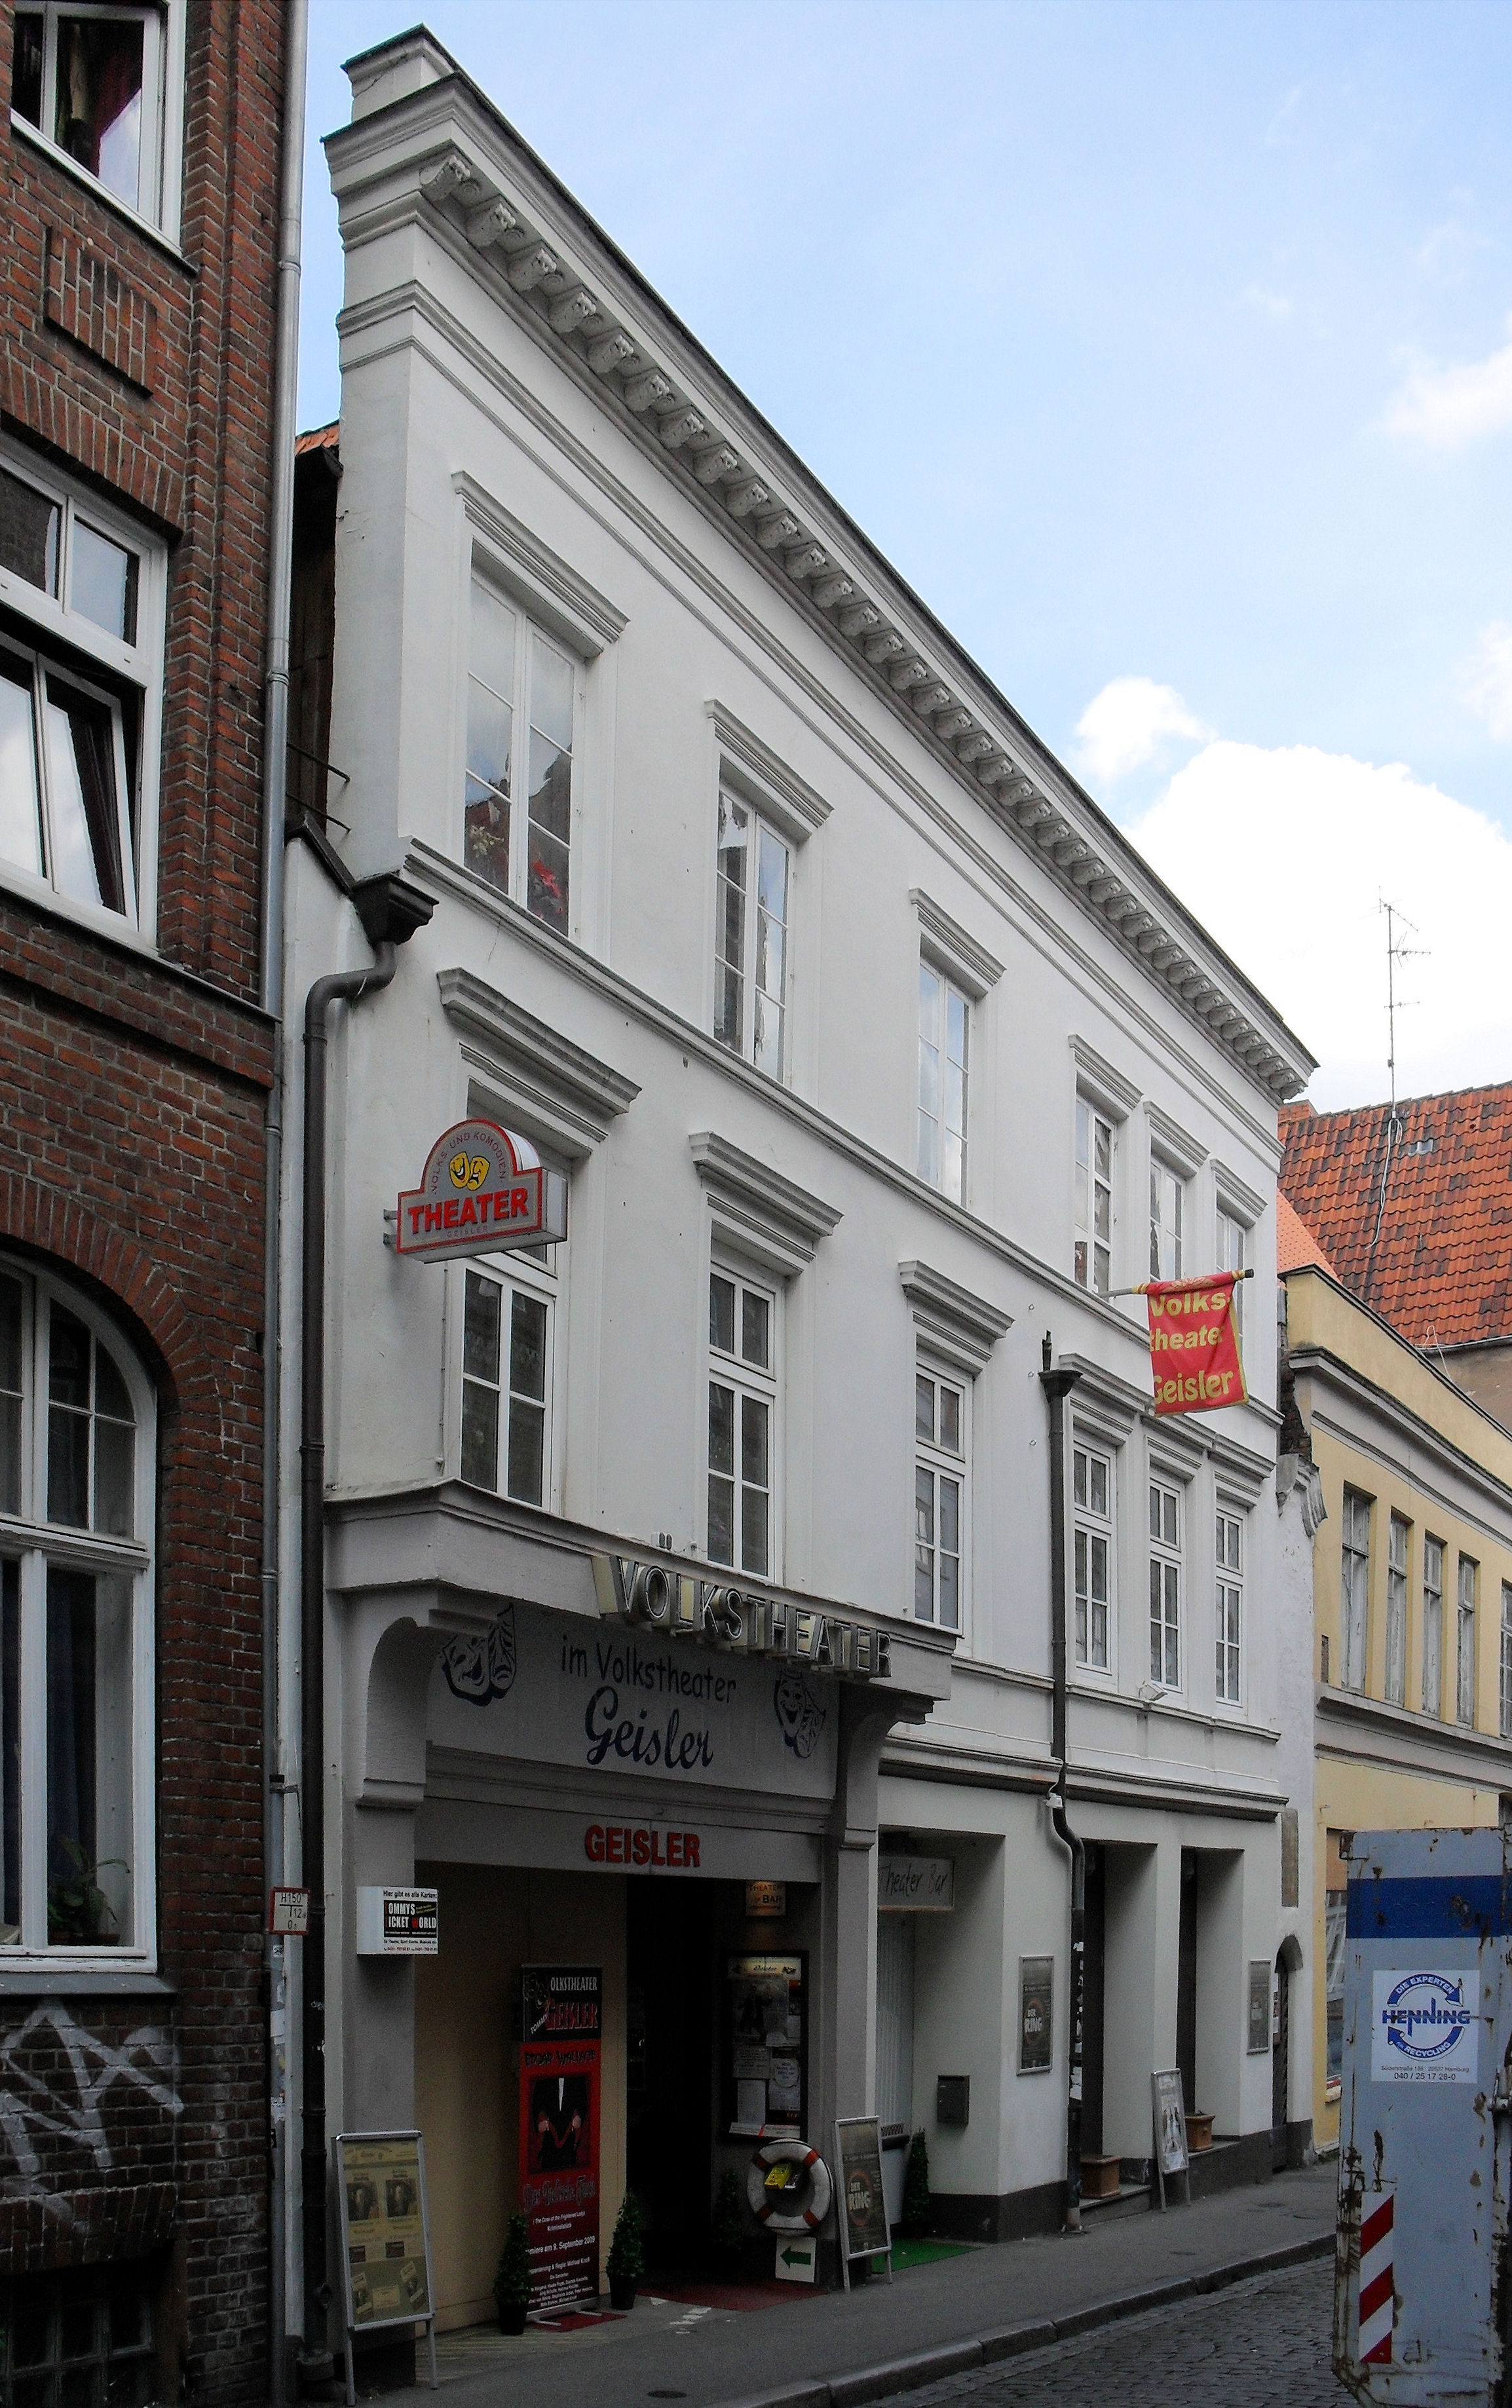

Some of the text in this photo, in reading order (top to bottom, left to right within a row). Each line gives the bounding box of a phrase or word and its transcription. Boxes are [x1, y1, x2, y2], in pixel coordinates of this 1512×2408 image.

[449, 1132, 470, 1149] UND
[407, 1187, 529, 1235] THEATER
[610, 1555, 892, 1677] VOLKSTHEATER
[561, 1635, 736, 1703] im Volkstheater
[584, 1685, 713, 1769] Geisler
[584, 1824, 700, 1868] GEISLER
[763, 1894, 782, 1903] BAR
[385, 1902, 415, 1915] TOMMYS
[385, 1915, 436, 1929] TICKET WORLD
[1395, 1976, 1454, 1994] DIE EXPERTEN
[544, 1997, 598, 2031] GEISLER
[1403, 2042, 1452, 2057] RECYCLING
[559, 2239, 584, 2251] September
